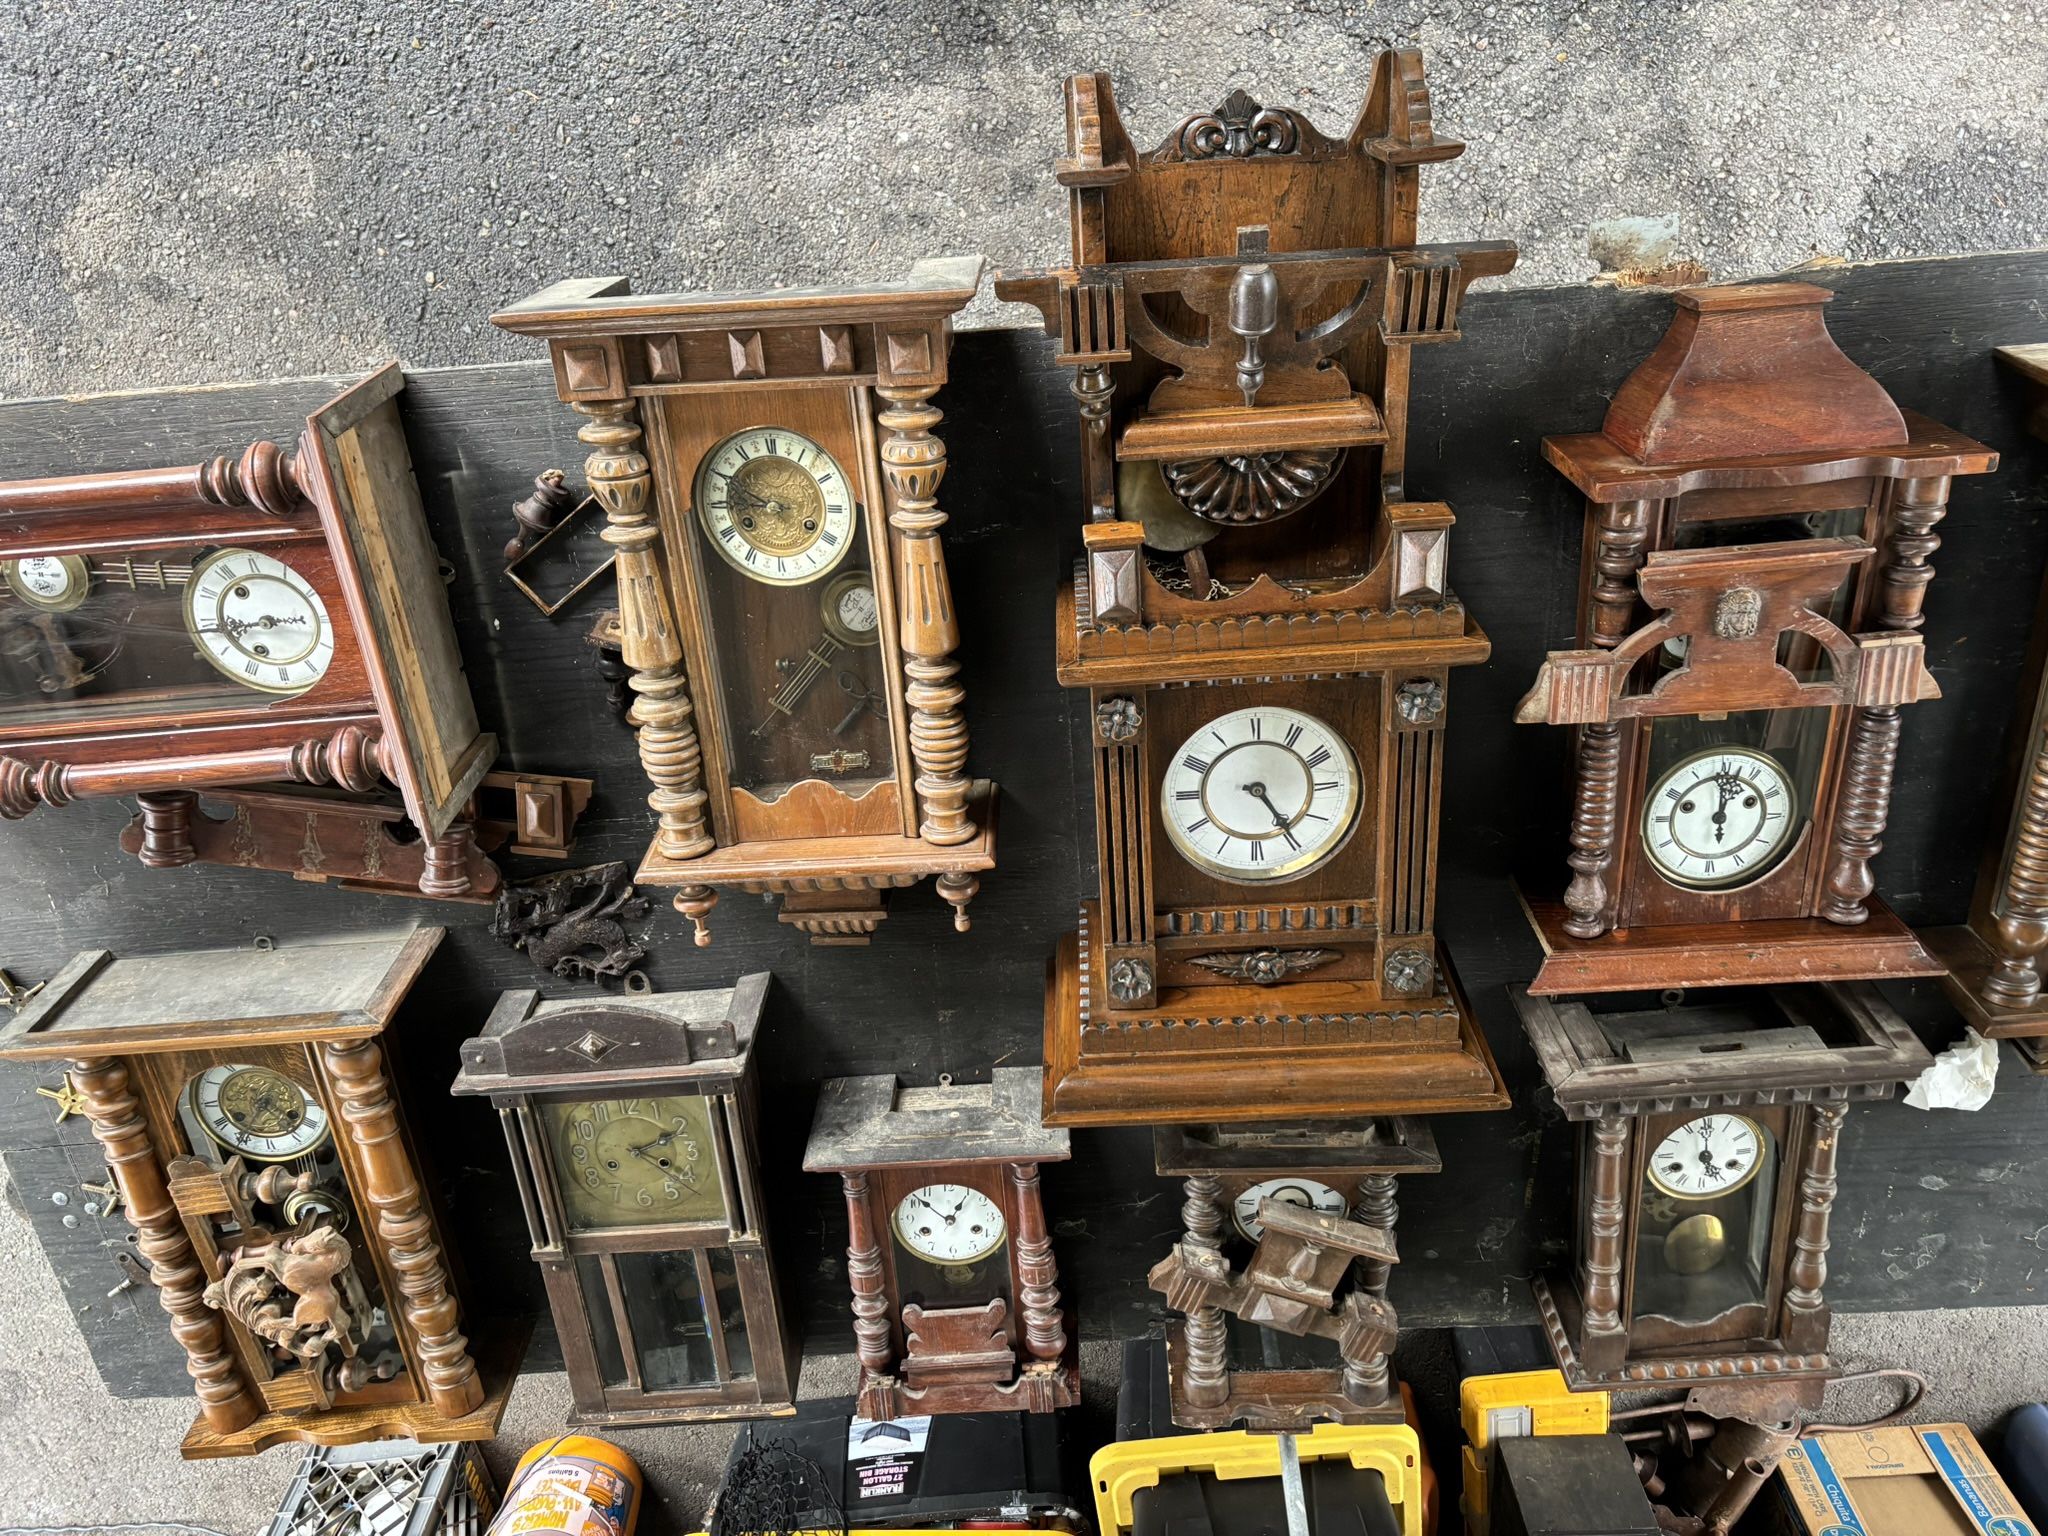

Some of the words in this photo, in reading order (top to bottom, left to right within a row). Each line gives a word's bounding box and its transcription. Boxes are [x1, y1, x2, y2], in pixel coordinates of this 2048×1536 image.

[828, 505, 842, 513] III
[1183, 755, 1209, 774] IIII
[1176, 791, 1199, 800] III
[1187, 818, 1209, 833] II
[591, 1103, 609, 1122] 11
[618, 1099, 639, 1115] 12
[651, 1101, 661, 1119] 1
[573, 1120, 595, 1141] 10
[672, 1117, 688, 1137] 2
[572, 1144, 588, 1165] 9
[684, 1141, 698, 1161] 3
[585, 1167, 600, 1188] 8
[680, 1165, 696, 1183] 4
[608, 1183, 622, 1203] 7
[637, 1188, 652, 1206] 6
[664, 1181, 679, 1200] 5
[910, 1199, 921, 1209] 10
[979, 1197, 988, 1207] 2
[907, 1214, 914, 1224] 9
[987, 1212, 995, 1222] 3
[928, 1241, 936, 1251] 7
[949, 1245, 957, 1254] 6
[969, 1241, 976, 1250] 5
[859, 1470, 873, 1478] BIN
[874, 1466, 908, 1476] STORAGE
[863, 1475, 893, 1485] GALLON
[861, 1483, 904, 1497] FRANKLIN
[1827, 1484, 1851, 1521] Chiquita
[1959, 1480, 1988, 1517] Bananas
